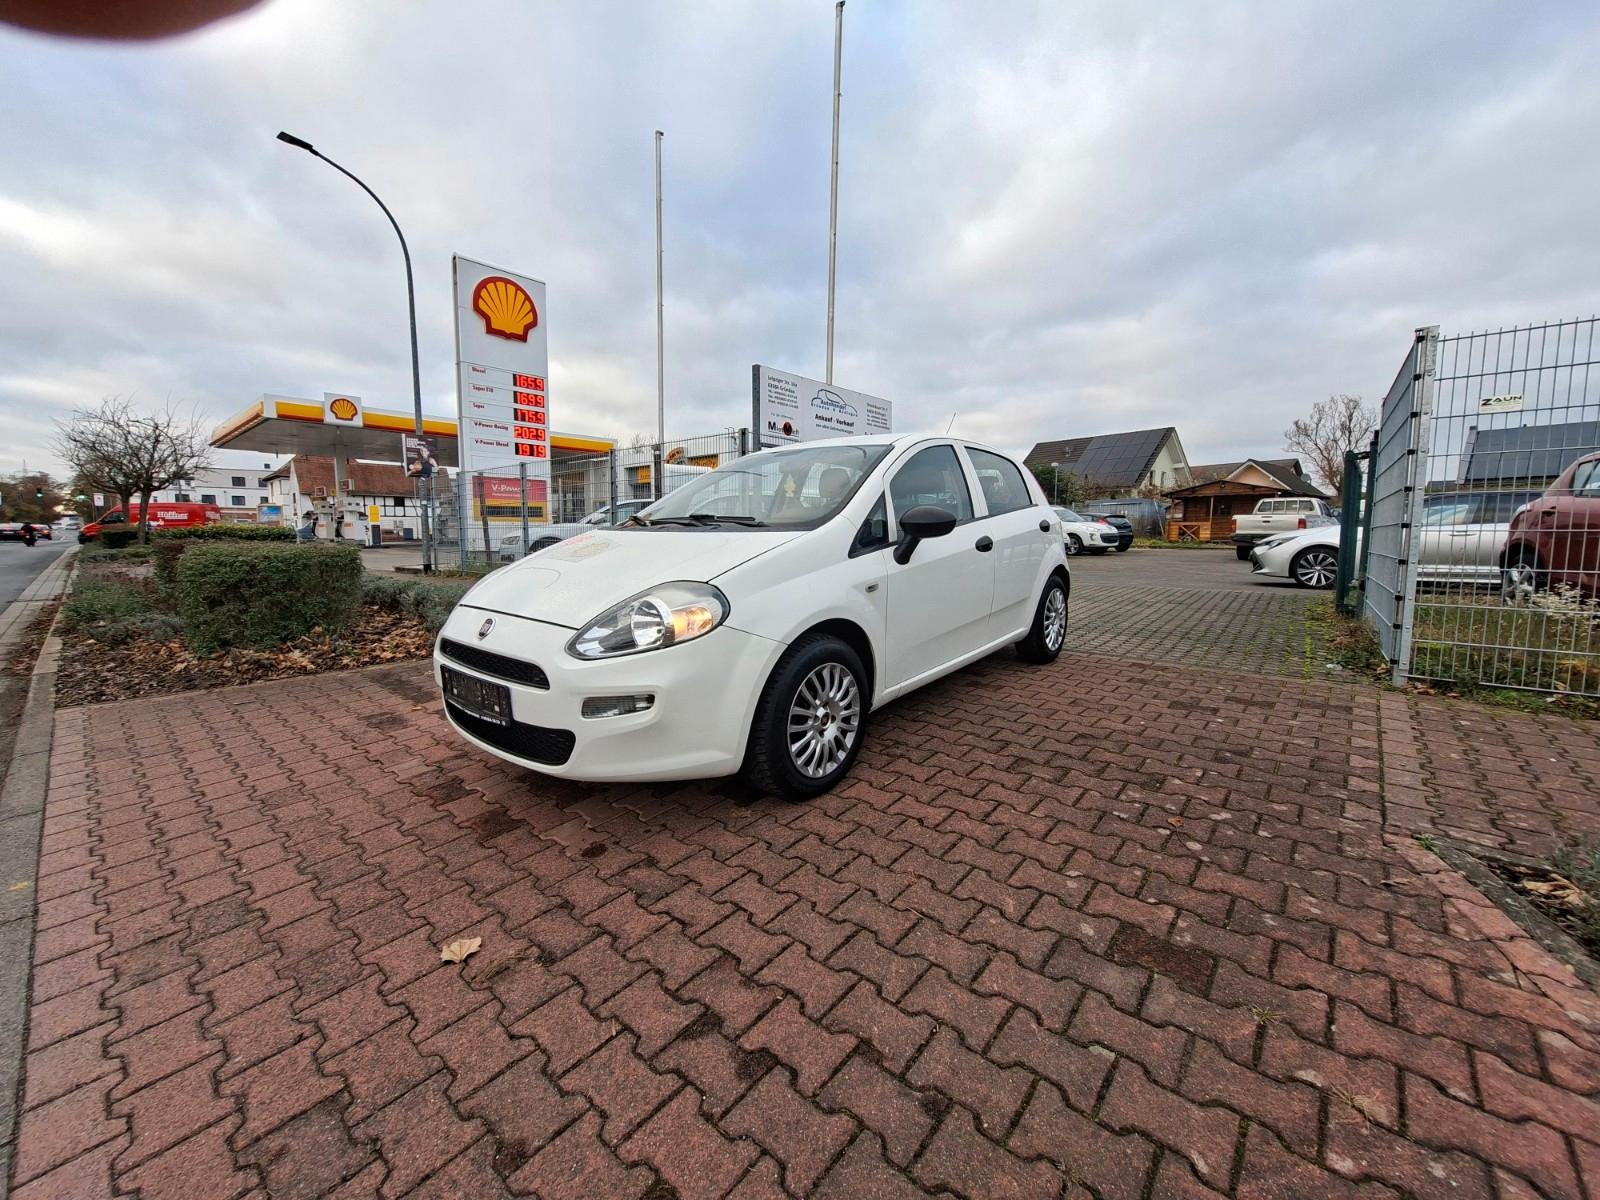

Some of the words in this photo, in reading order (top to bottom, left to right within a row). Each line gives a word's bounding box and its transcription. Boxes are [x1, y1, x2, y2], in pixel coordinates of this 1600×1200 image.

[472, 366, 486, 374] Diesel
[1481, 395, 1522, 406] ZAUN
[815, 413, 833, 423] Ankauf
[836, 417, 855, 428] Verkauf
